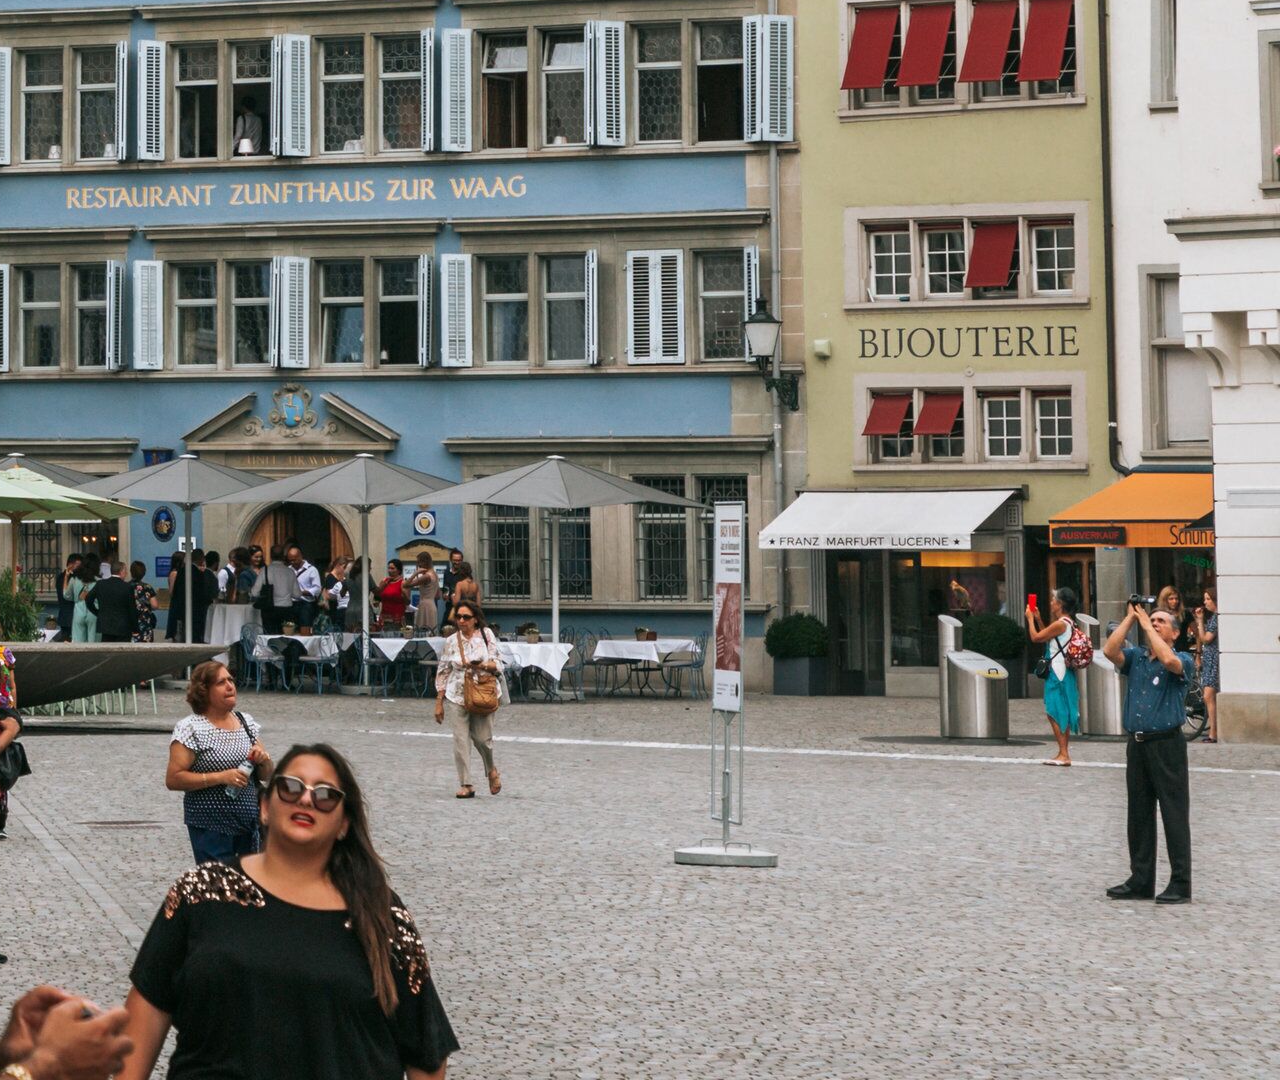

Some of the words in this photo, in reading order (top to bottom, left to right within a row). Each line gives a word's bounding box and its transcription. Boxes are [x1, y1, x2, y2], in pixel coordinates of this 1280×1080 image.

[65, 184, 216, 209] RESTAURANT
[229, 180, 375, 205] ZUNFTHAUS
[386, 178, 436, 201] ZUR
[449, 175, 527, 199] WAAG
[858, 326, 1080, 359] BIJOUTERIE
[779, 537, 820, 547] FRANZ
[826, 537, 885, 547] MARFURT
[891, 537, 949, 547] LUCERNE
[1060, 531, 1119, 540] AUSVERKAUF
